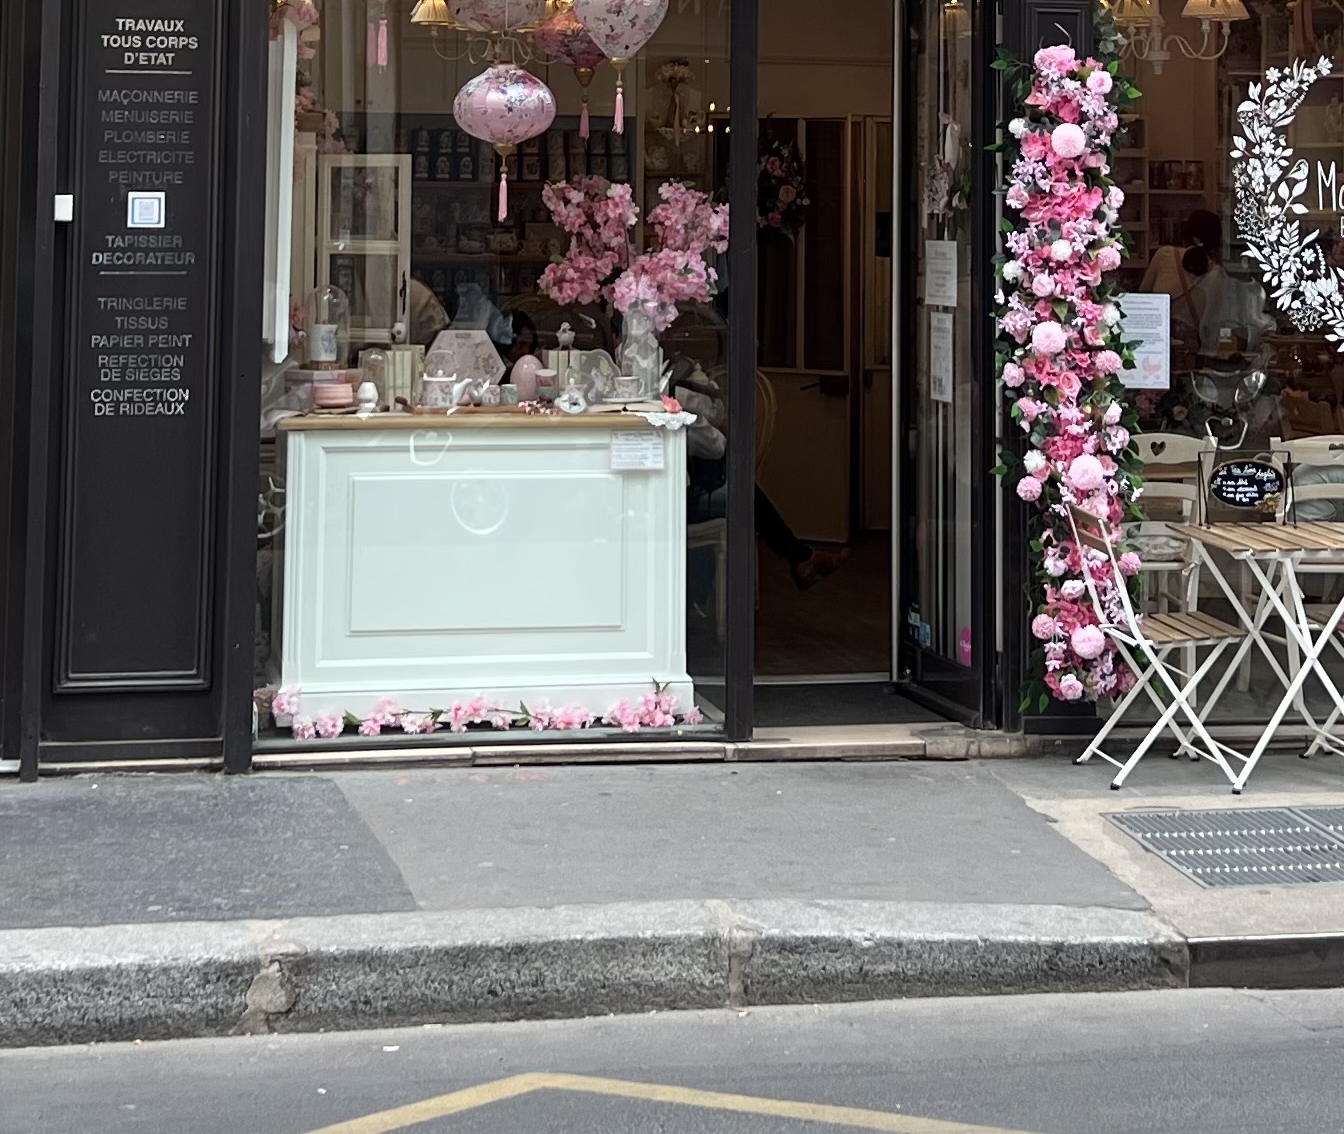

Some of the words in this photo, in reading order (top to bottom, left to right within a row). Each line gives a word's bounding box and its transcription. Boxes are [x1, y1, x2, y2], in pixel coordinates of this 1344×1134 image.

[115, 18, 184, 32] TRAVAUX
[101, 35, 142, 48] TOUS
[146, 36, 198, 49] CORPS
[124, 52, 175, 65] D'ETAT
[98, 90, 199, 105] MAÇONNERIE
[102, 111, 194, 124] MENUISERIE
[104, 130, 190, 144] PLOMBERIE
[98, 150, 195, 164] ELECTRICITE
[109, 171, 184, 184] PEINTURE
[106, 235, 183, 248] TAPISSIER
[91, 252, 195, 265] DECORATEUR
[97, 297, 187, 310] TRINGLERIE
[115, 317, 169, 329] TISSUS
[91, 335, 144, 348] PAPIER
[148, 335, 192, 348] PEINT
[98, 355, 184, 367] REFECTION
[100, 368, 121, 381] DE
[125, 368, 181, 381] SIEGES
[90, 388, 189, 402] CONFECTION
[94, 403, 115, 416] DE
[119, 402, 185, 415] RIDEAUX
